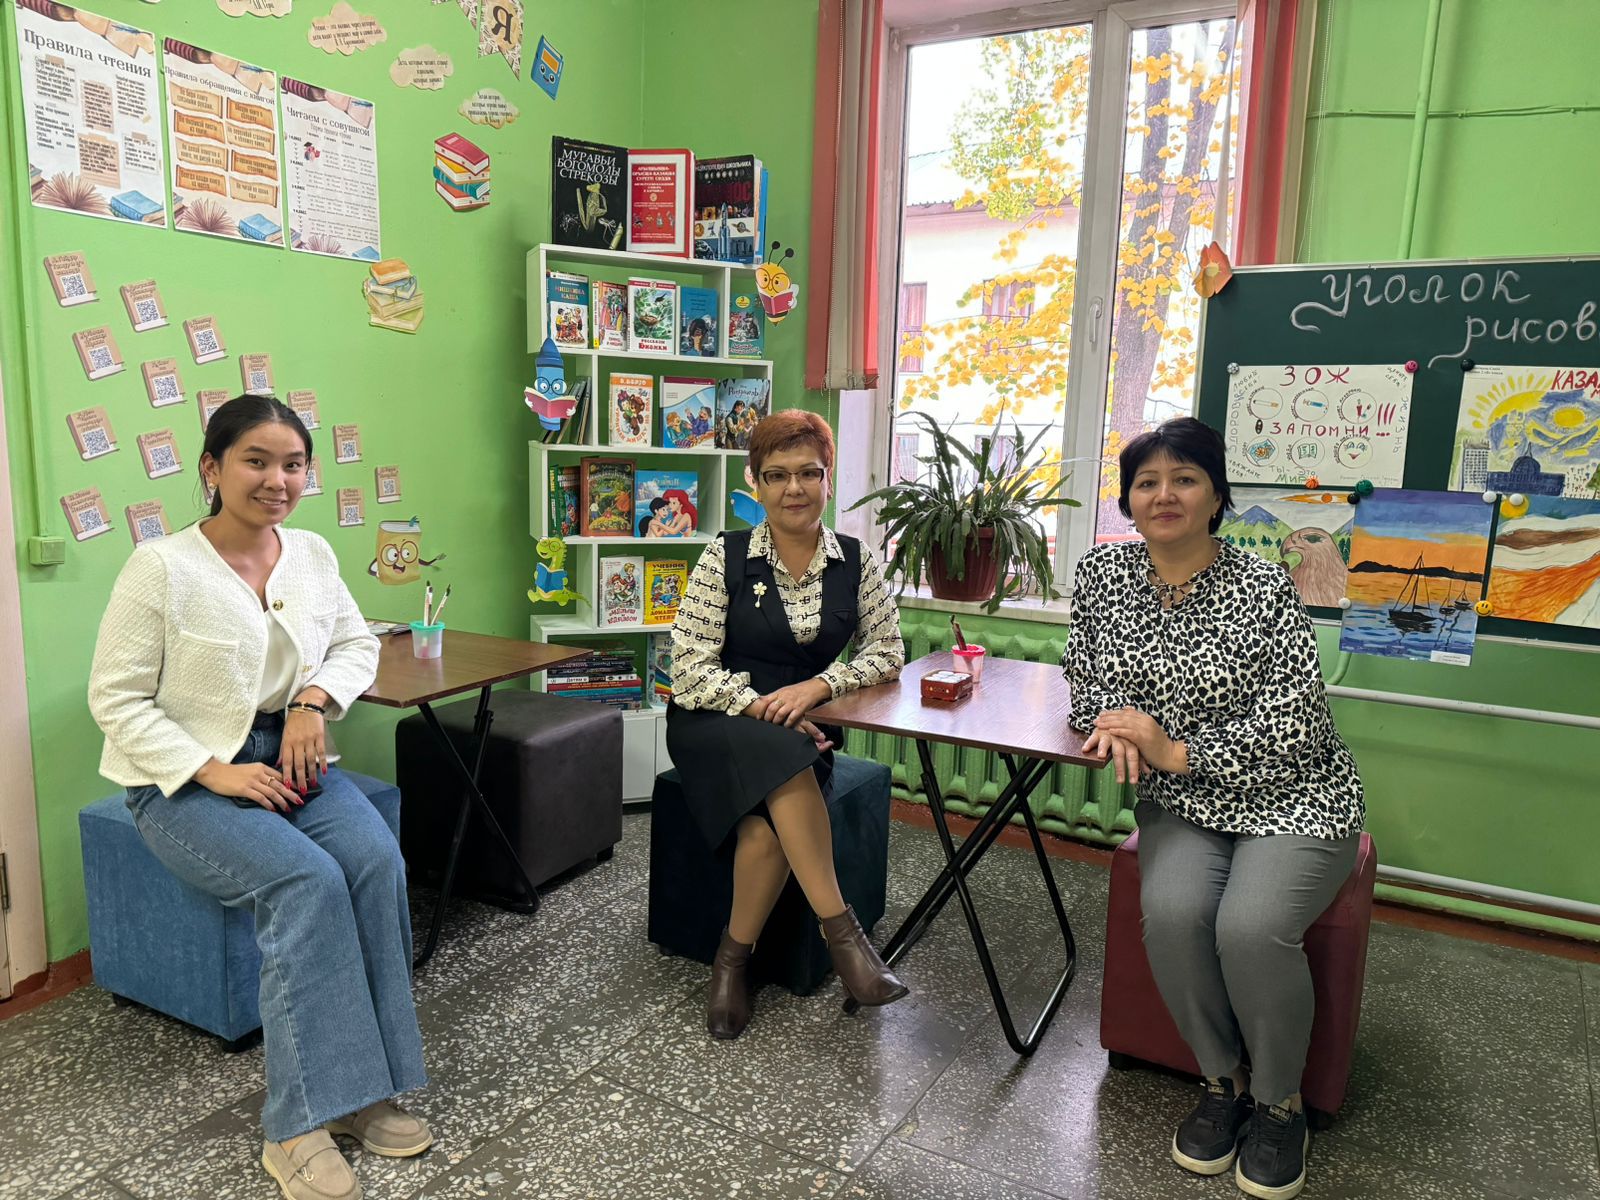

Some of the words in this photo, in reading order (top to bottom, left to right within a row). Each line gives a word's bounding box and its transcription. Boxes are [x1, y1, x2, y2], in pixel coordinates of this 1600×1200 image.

[492, 6, 513, 44] Я
[24, 28, 93, 60] Правила
[98, 53, 152, 78] чтения
[165, 66, 198, 82] Правила
[200, 79, 242, 96] обращения
[250, 93, 275, 105] книгой
[286, 106, 320, 124] Читаем
[329, 120, 370, 136] совушкой
[557, 158, 621, 176] БОГОМОЛЫ
[562, 149, 616, 166] МУРАВЬИ
[560, 169, 618, 186] СТРЕКОЗЫ
[1427, 301, 1600, 368] рисов
[1280, 366, 1350, 386] ЗОЖ
[1551, 370, 1600, 390] КАЗА
